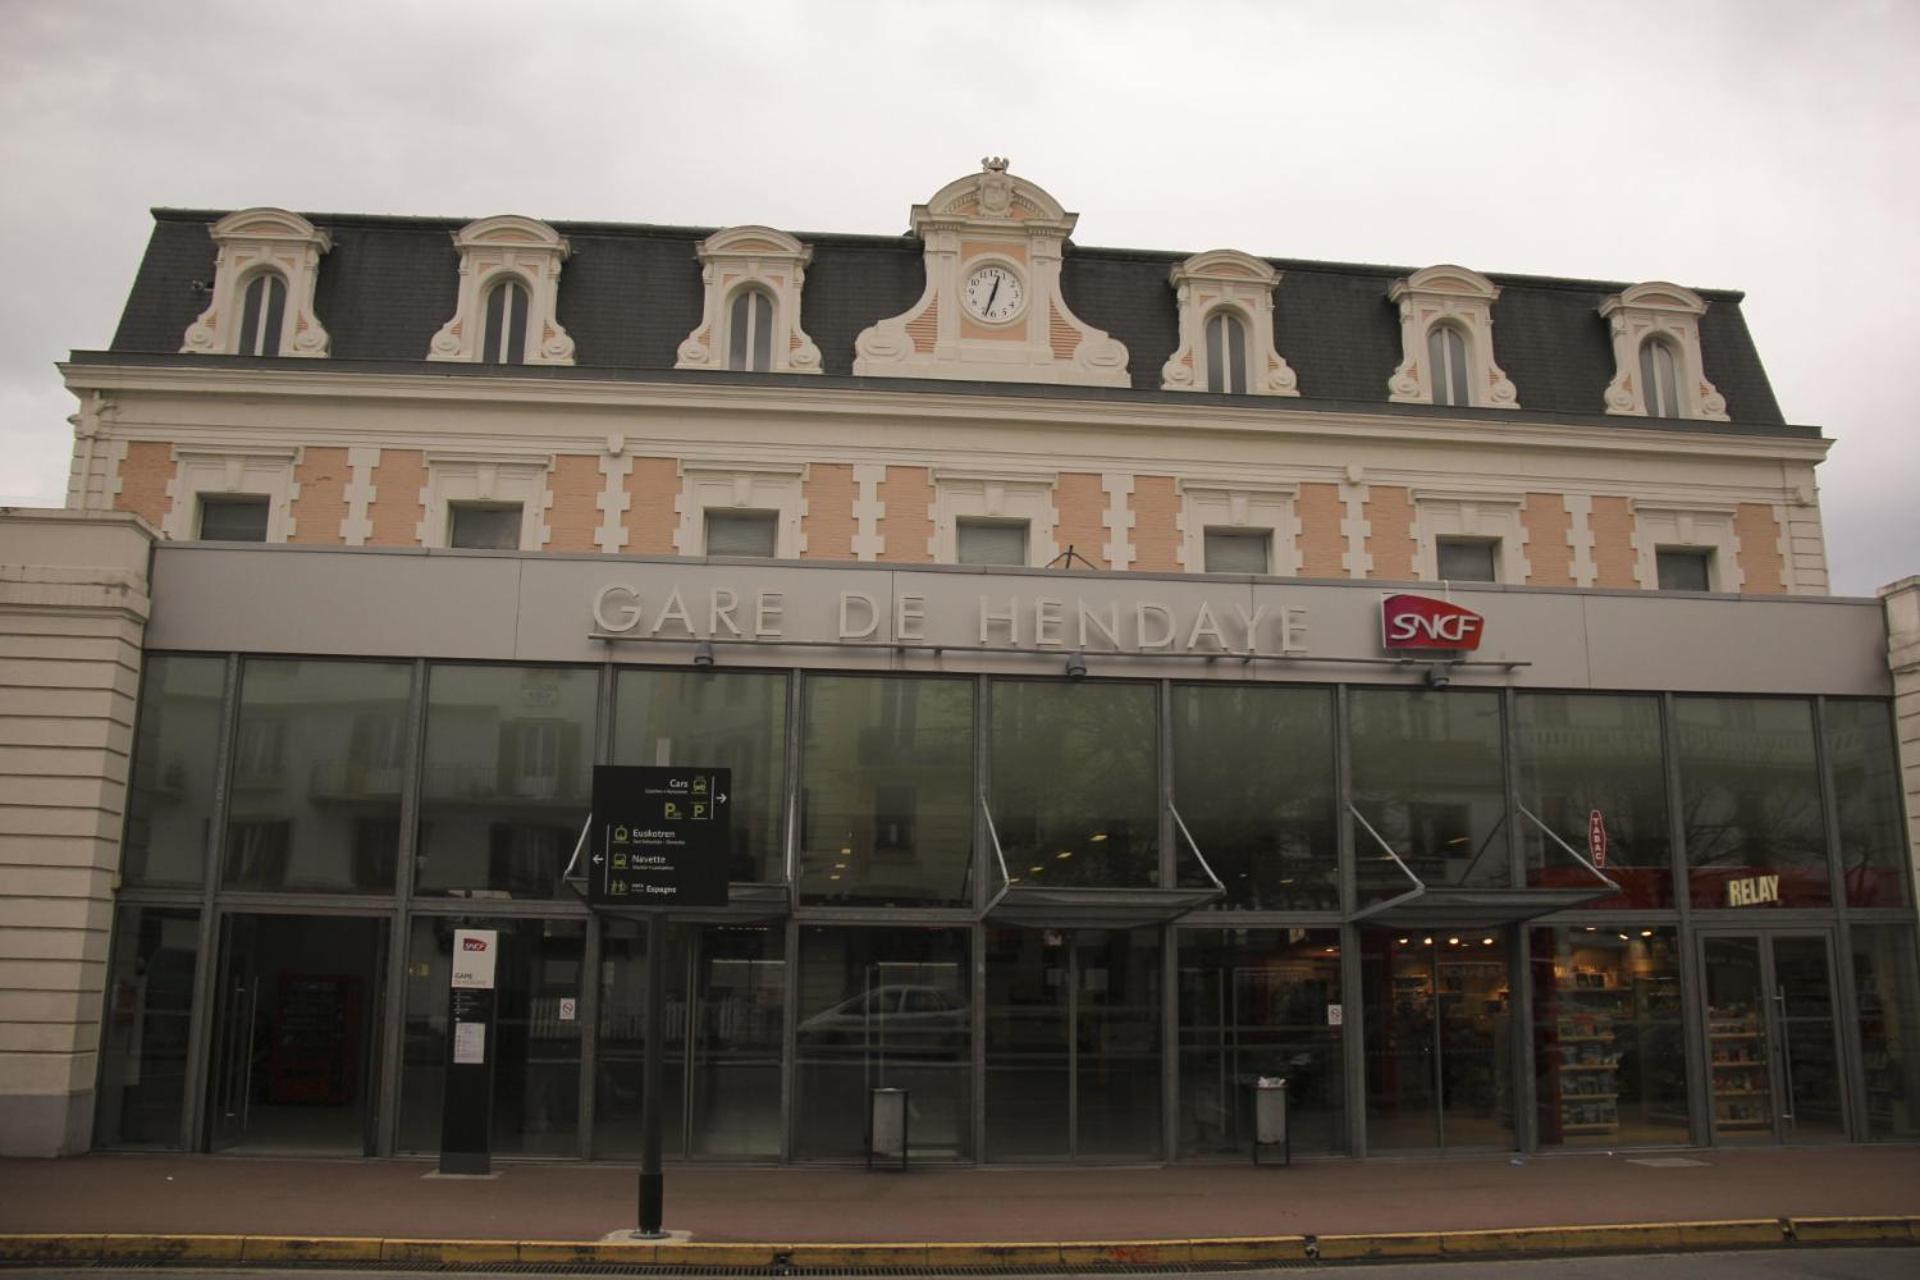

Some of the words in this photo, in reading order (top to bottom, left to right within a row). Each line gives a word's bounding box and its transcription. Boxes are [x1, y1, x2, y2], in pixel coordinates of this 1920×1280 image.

[593, 583, 785, 637] GARE
[839, 591, 925, 641] DE
[979, 595, 1308, 654] HENDAYE
[1391, 613, 1480, 641] SNCF
[669, 778, 688, 789] Cars
[665, 802, 676, 818] P
[694, 804, 704, 817] P
[632, 828, 676, 838] Euskotren
[1592, 817, 1603, 860] TABAC
[631, 854, 667, 864] Navette
[1728, 875, 1779, 907] RELAY
